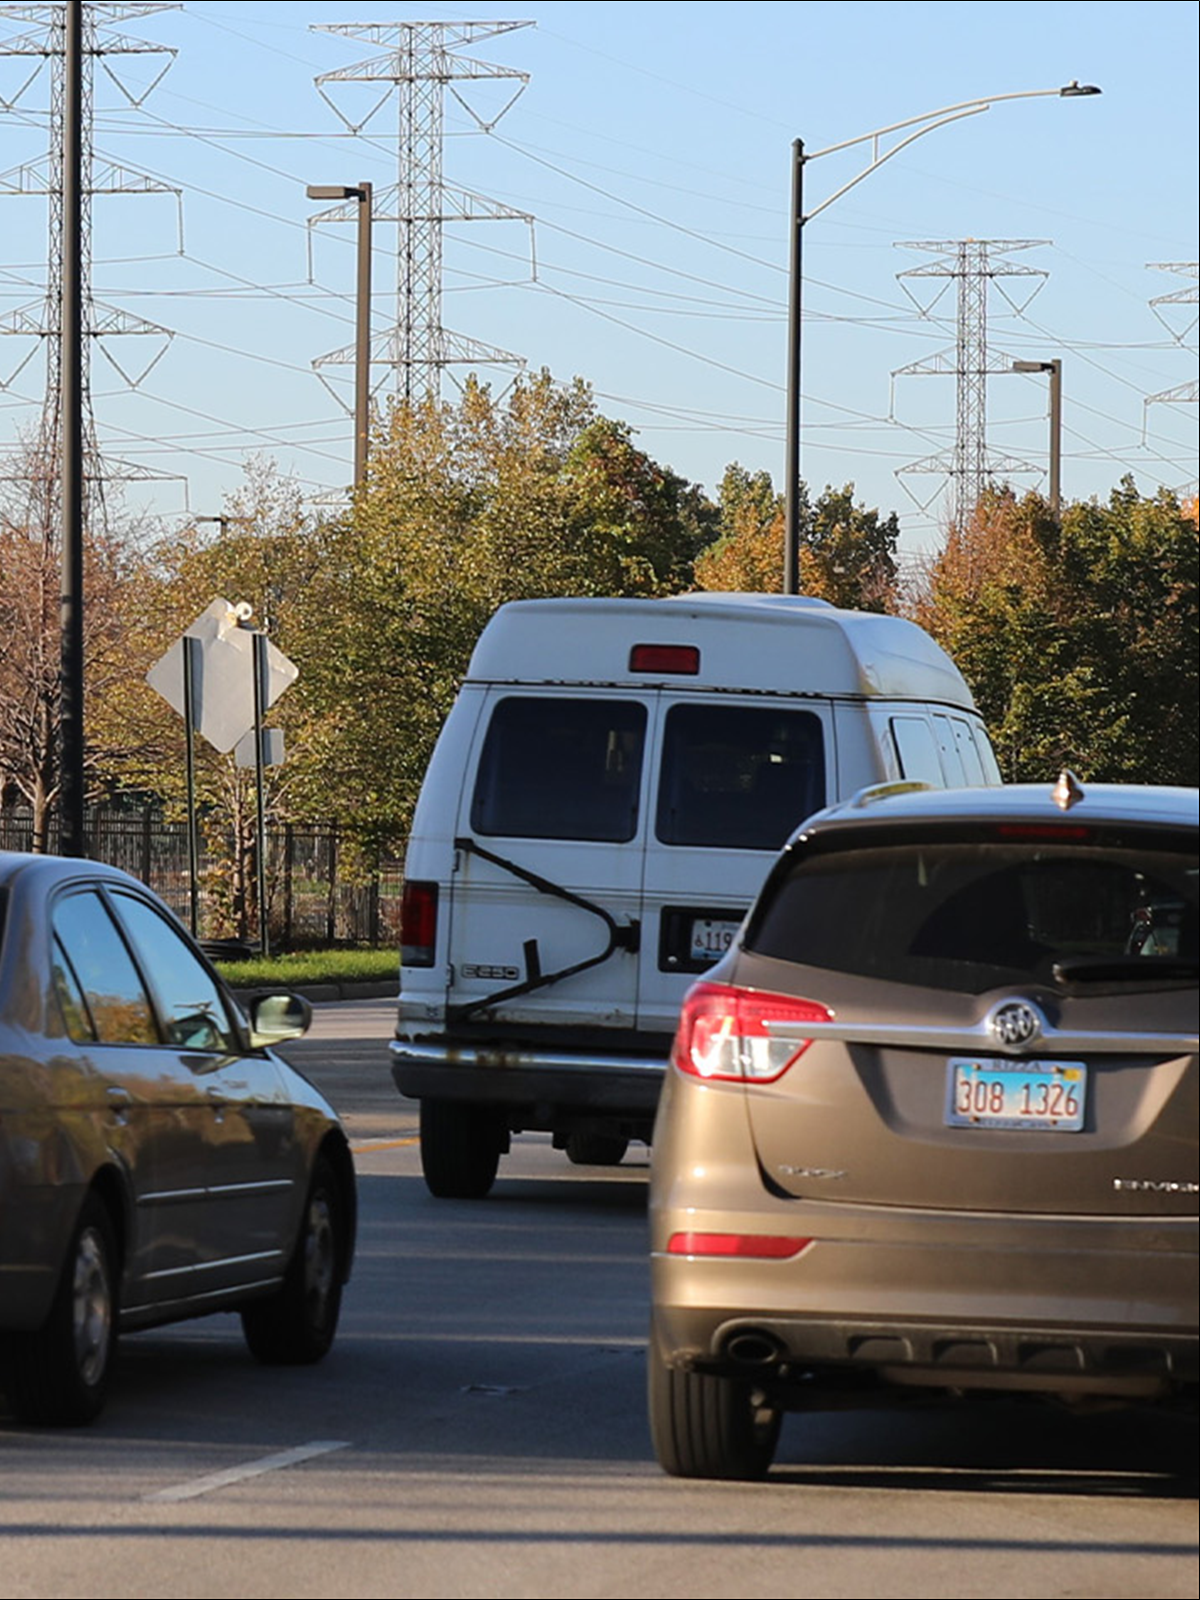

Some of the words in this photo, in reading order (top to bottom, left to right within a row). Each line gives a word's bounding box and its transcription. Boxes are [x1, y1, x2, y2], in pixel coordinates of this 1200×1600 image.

[705, 931, 733, 951] 119
[958, 1080, 1004, 1113] 308
[1020, 1082, 1079, 1116] 1326
